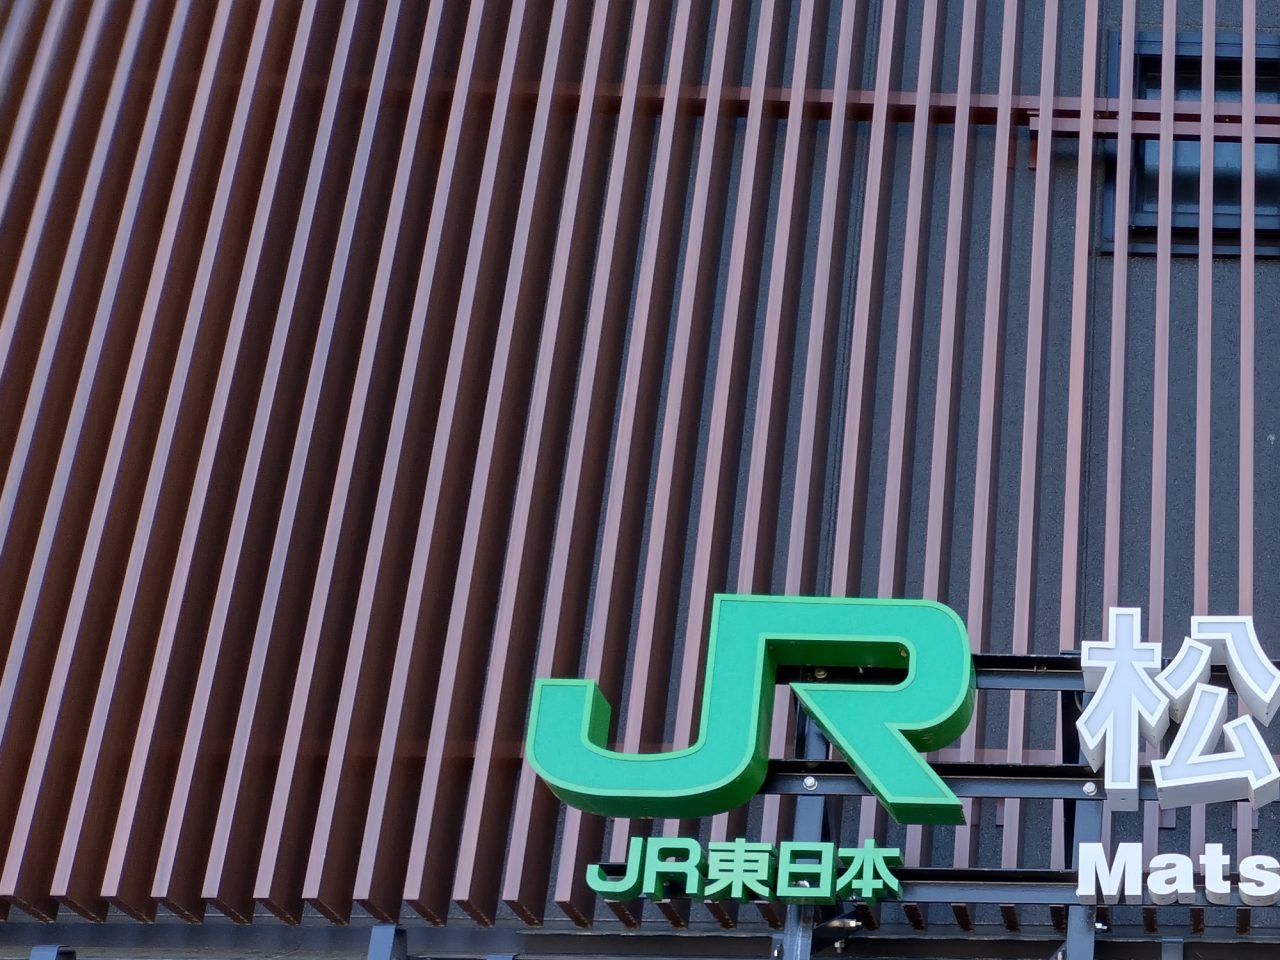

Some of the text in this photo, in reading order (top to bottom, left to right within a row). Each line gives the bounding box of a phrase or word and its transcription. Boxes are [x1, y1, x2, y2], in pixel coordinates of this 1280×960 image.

[526, 592, 976, 824] JR
[585, 835, 903, 904] JR東日本
